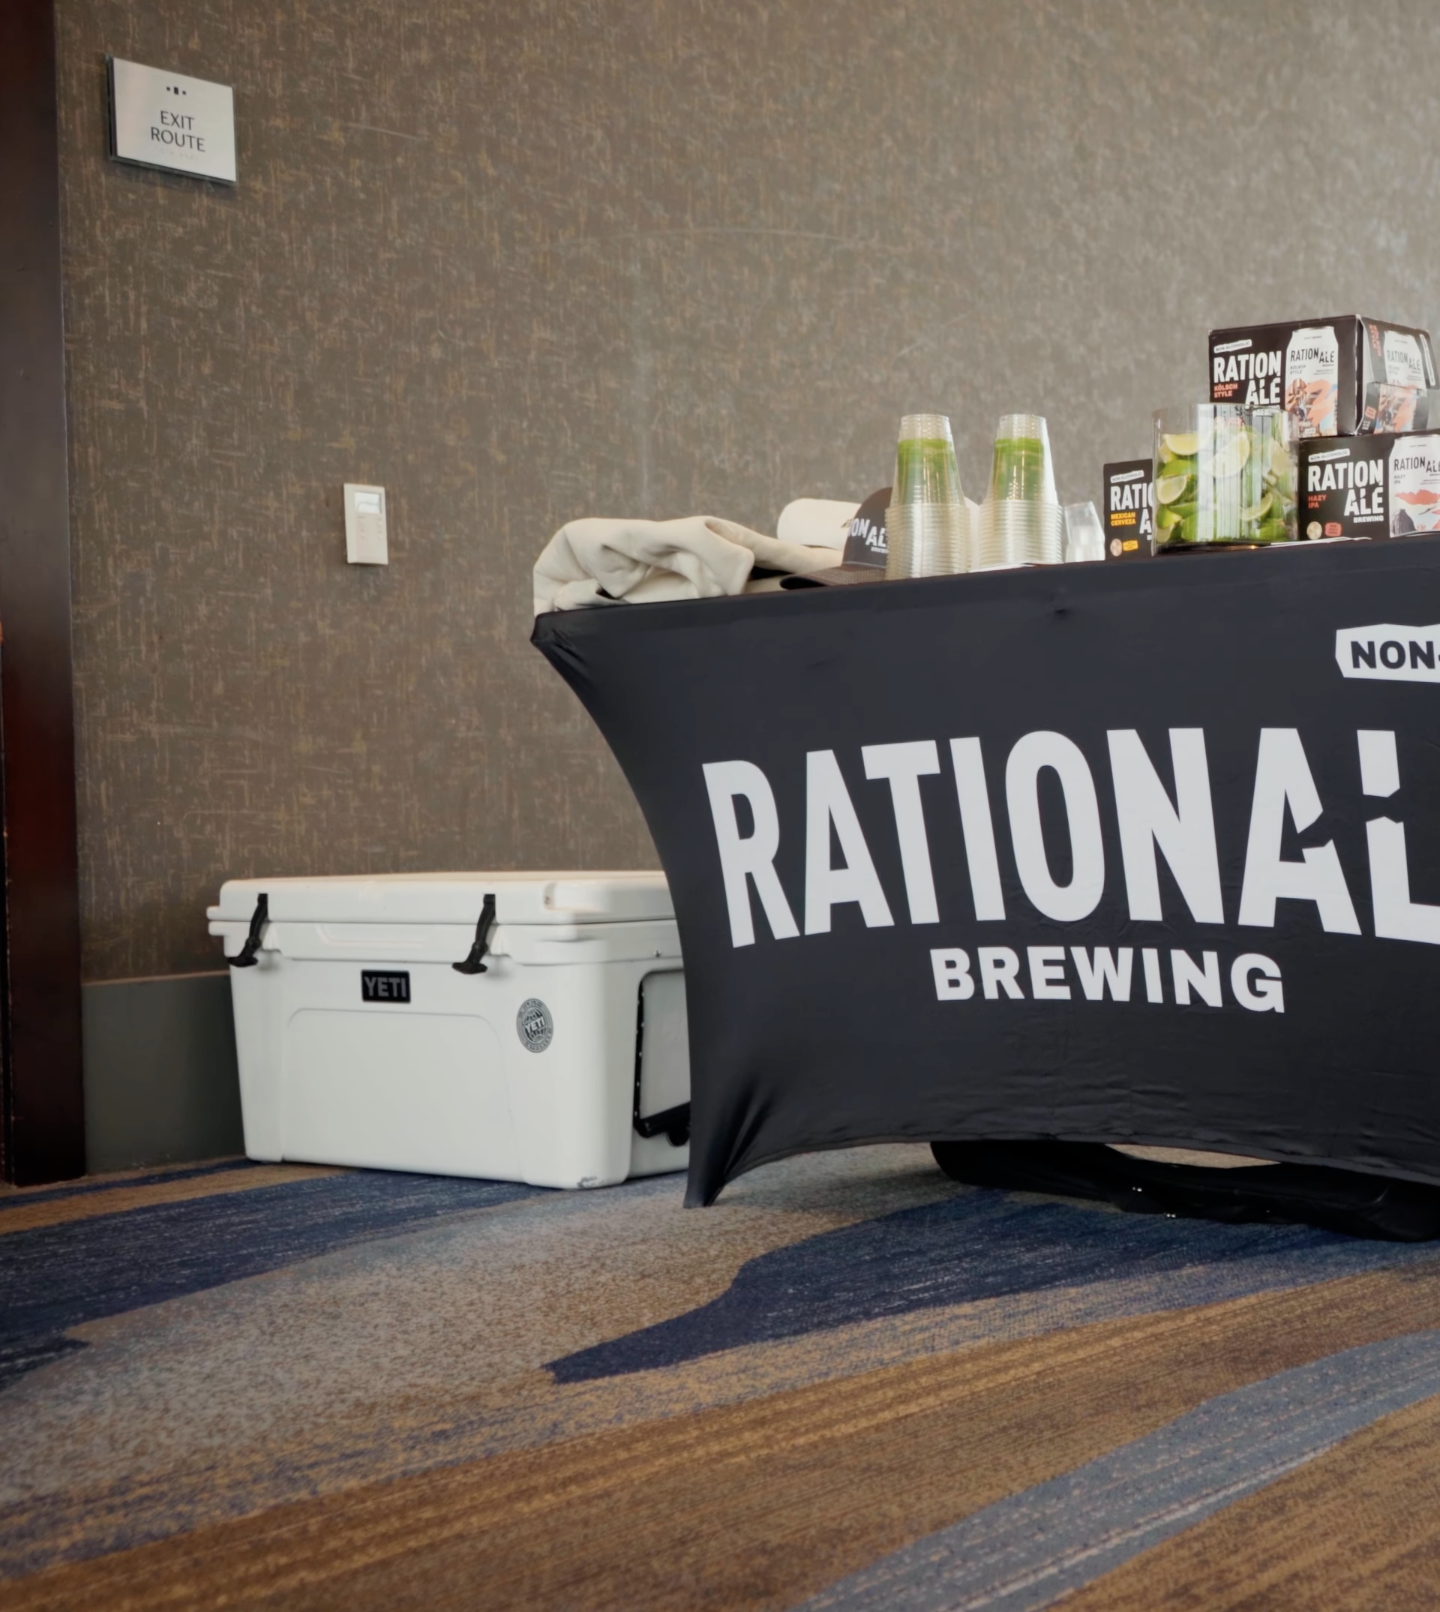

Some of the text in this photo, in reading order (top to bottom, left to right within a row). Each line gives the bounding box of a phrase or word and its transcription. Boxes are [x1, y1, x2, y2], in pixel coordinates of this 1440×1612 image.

[160, 110, 195, 131] EXIT
[150, 126, 206, 153] ROUTE
[1290, 347, 1335, 364] RATIONALE
[1386, 349, 1421, 371] RATIONALE
[1214, 351, 1281, 383] RATION
[1214, 390, 1233, 399] STYLE
[1245, 377, 1281, 407] ALE
[1307, 459, 1384, 492] RATION
[1344, 487, 1384, 516] ALE
[1110, 511, 1136, 520] MEXICAN
[1110, 518, 1136, 527] CERVEZA
[1353, 515, 1384, 523] BREWING
[364, 976, 408, 998] YETI
[929, 945, 1285, 1014] BREWING
[524, 1017, 545, 1034] YETI
